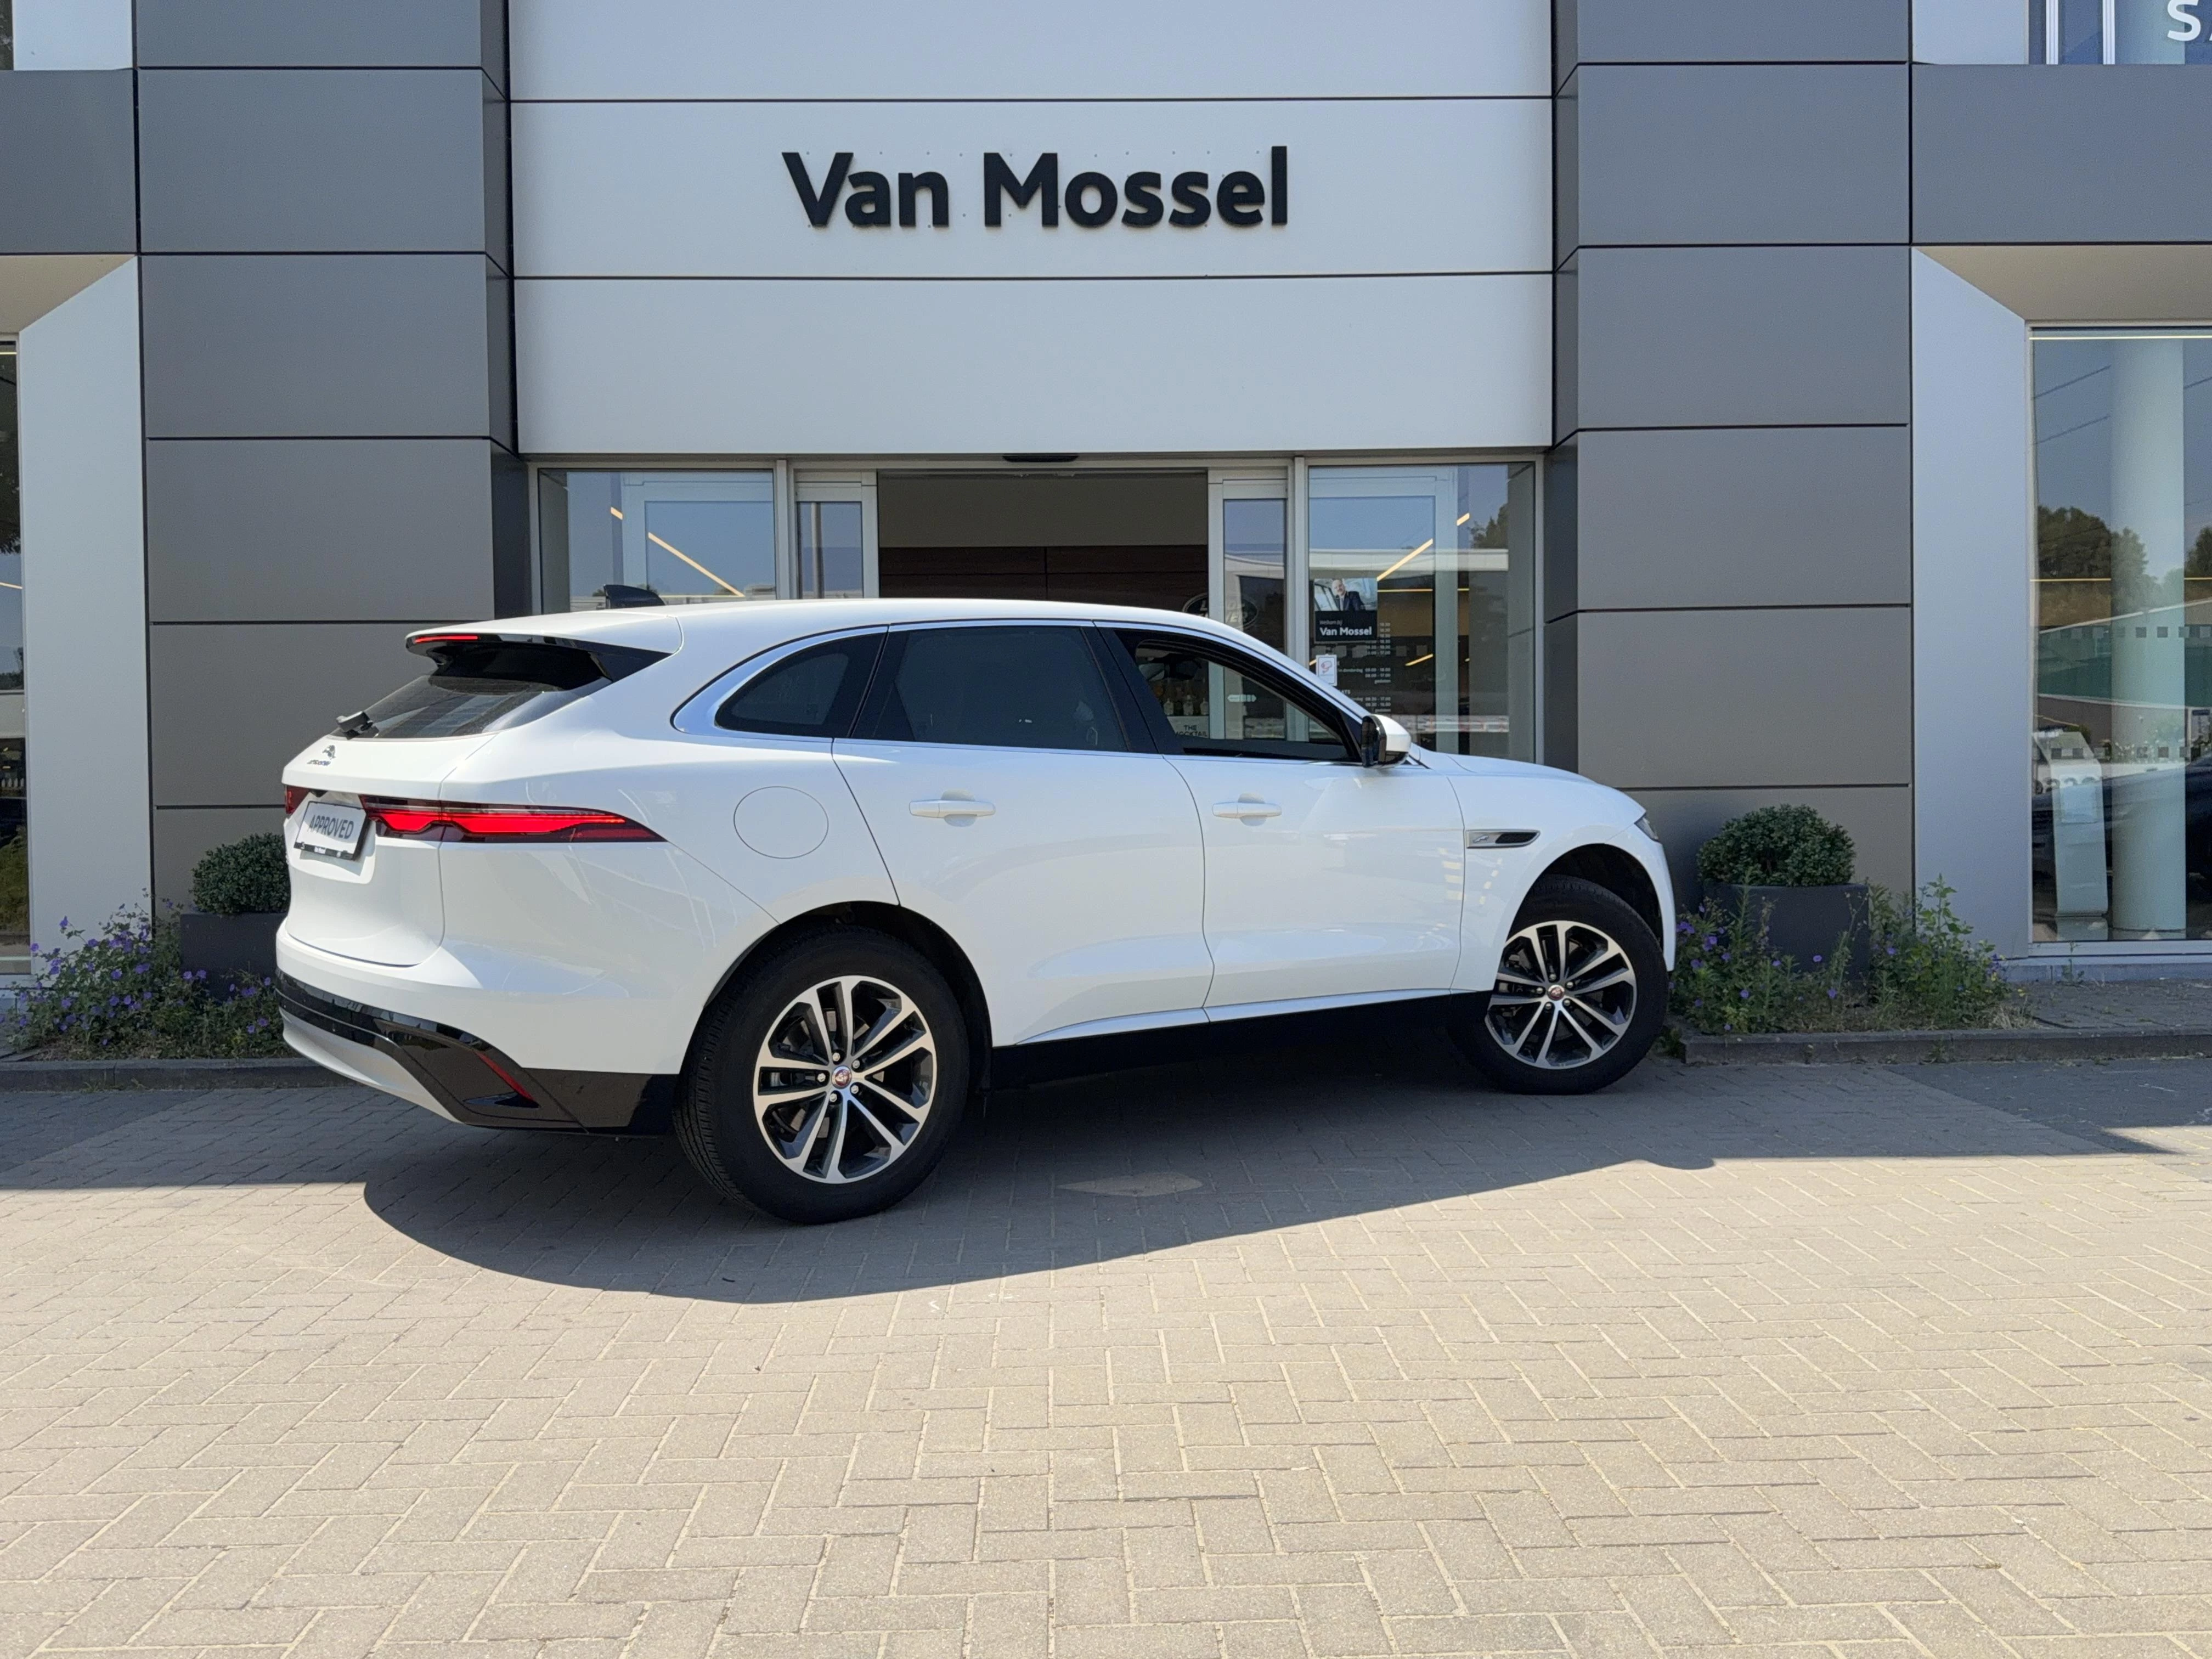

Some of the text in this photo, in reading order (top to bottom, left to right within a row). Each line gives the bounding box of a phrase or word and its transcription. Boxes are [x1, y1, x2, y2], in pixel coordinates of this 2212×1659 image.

[2168, 0, 2212, 41] S
[782, 145, 1288, 228] Van Mossel
[1319, 626, 1372, 635] Van Mossel
[308, 815, 354, 839] APPROVED
